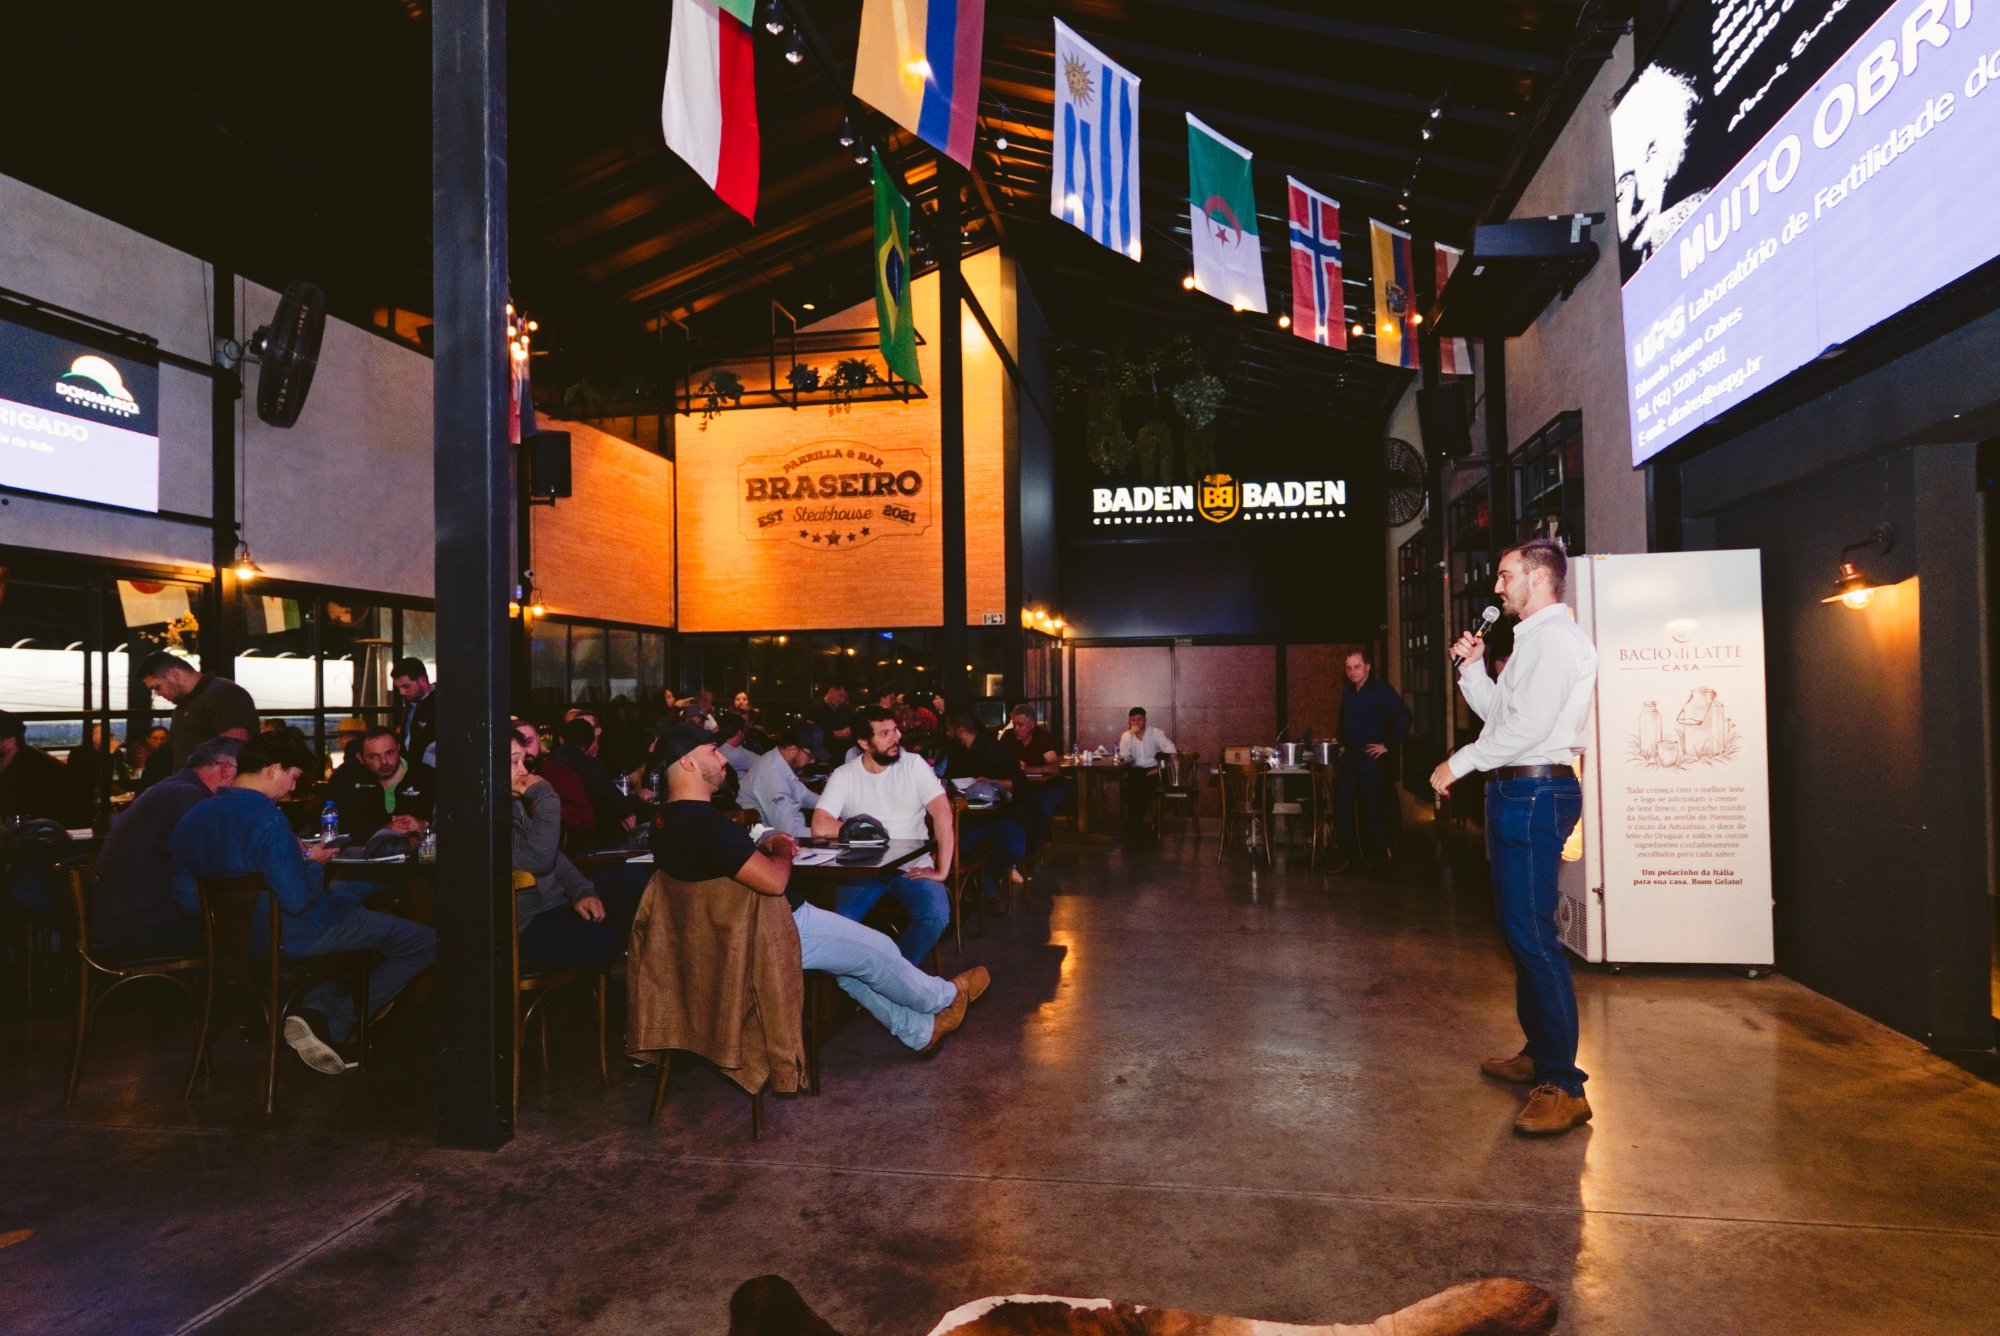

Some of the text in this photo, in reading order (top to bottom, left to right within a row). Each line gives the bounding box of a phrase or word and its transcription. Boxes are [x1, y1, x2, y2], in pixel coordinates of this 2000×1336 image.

[1679, 134, 1801, 280] MUITO
[1688, 239, 1777, 323] Laboratório
[1781, 211, 1808, 246] de
[1814, 92, 1956, 220] Fertilidade
[783, 449, 884, 474] PARRILLA & BAR
[745, 470, 922, 502] BRASEIRO
[1092, 485, 1194, 513] BADEN
[1242, 480, 1346, 507] BADEN
[757, 504, 917, 528] EST Steakhouse 2021
[1620, 646, 1742, 661] BACIO di LATTE
